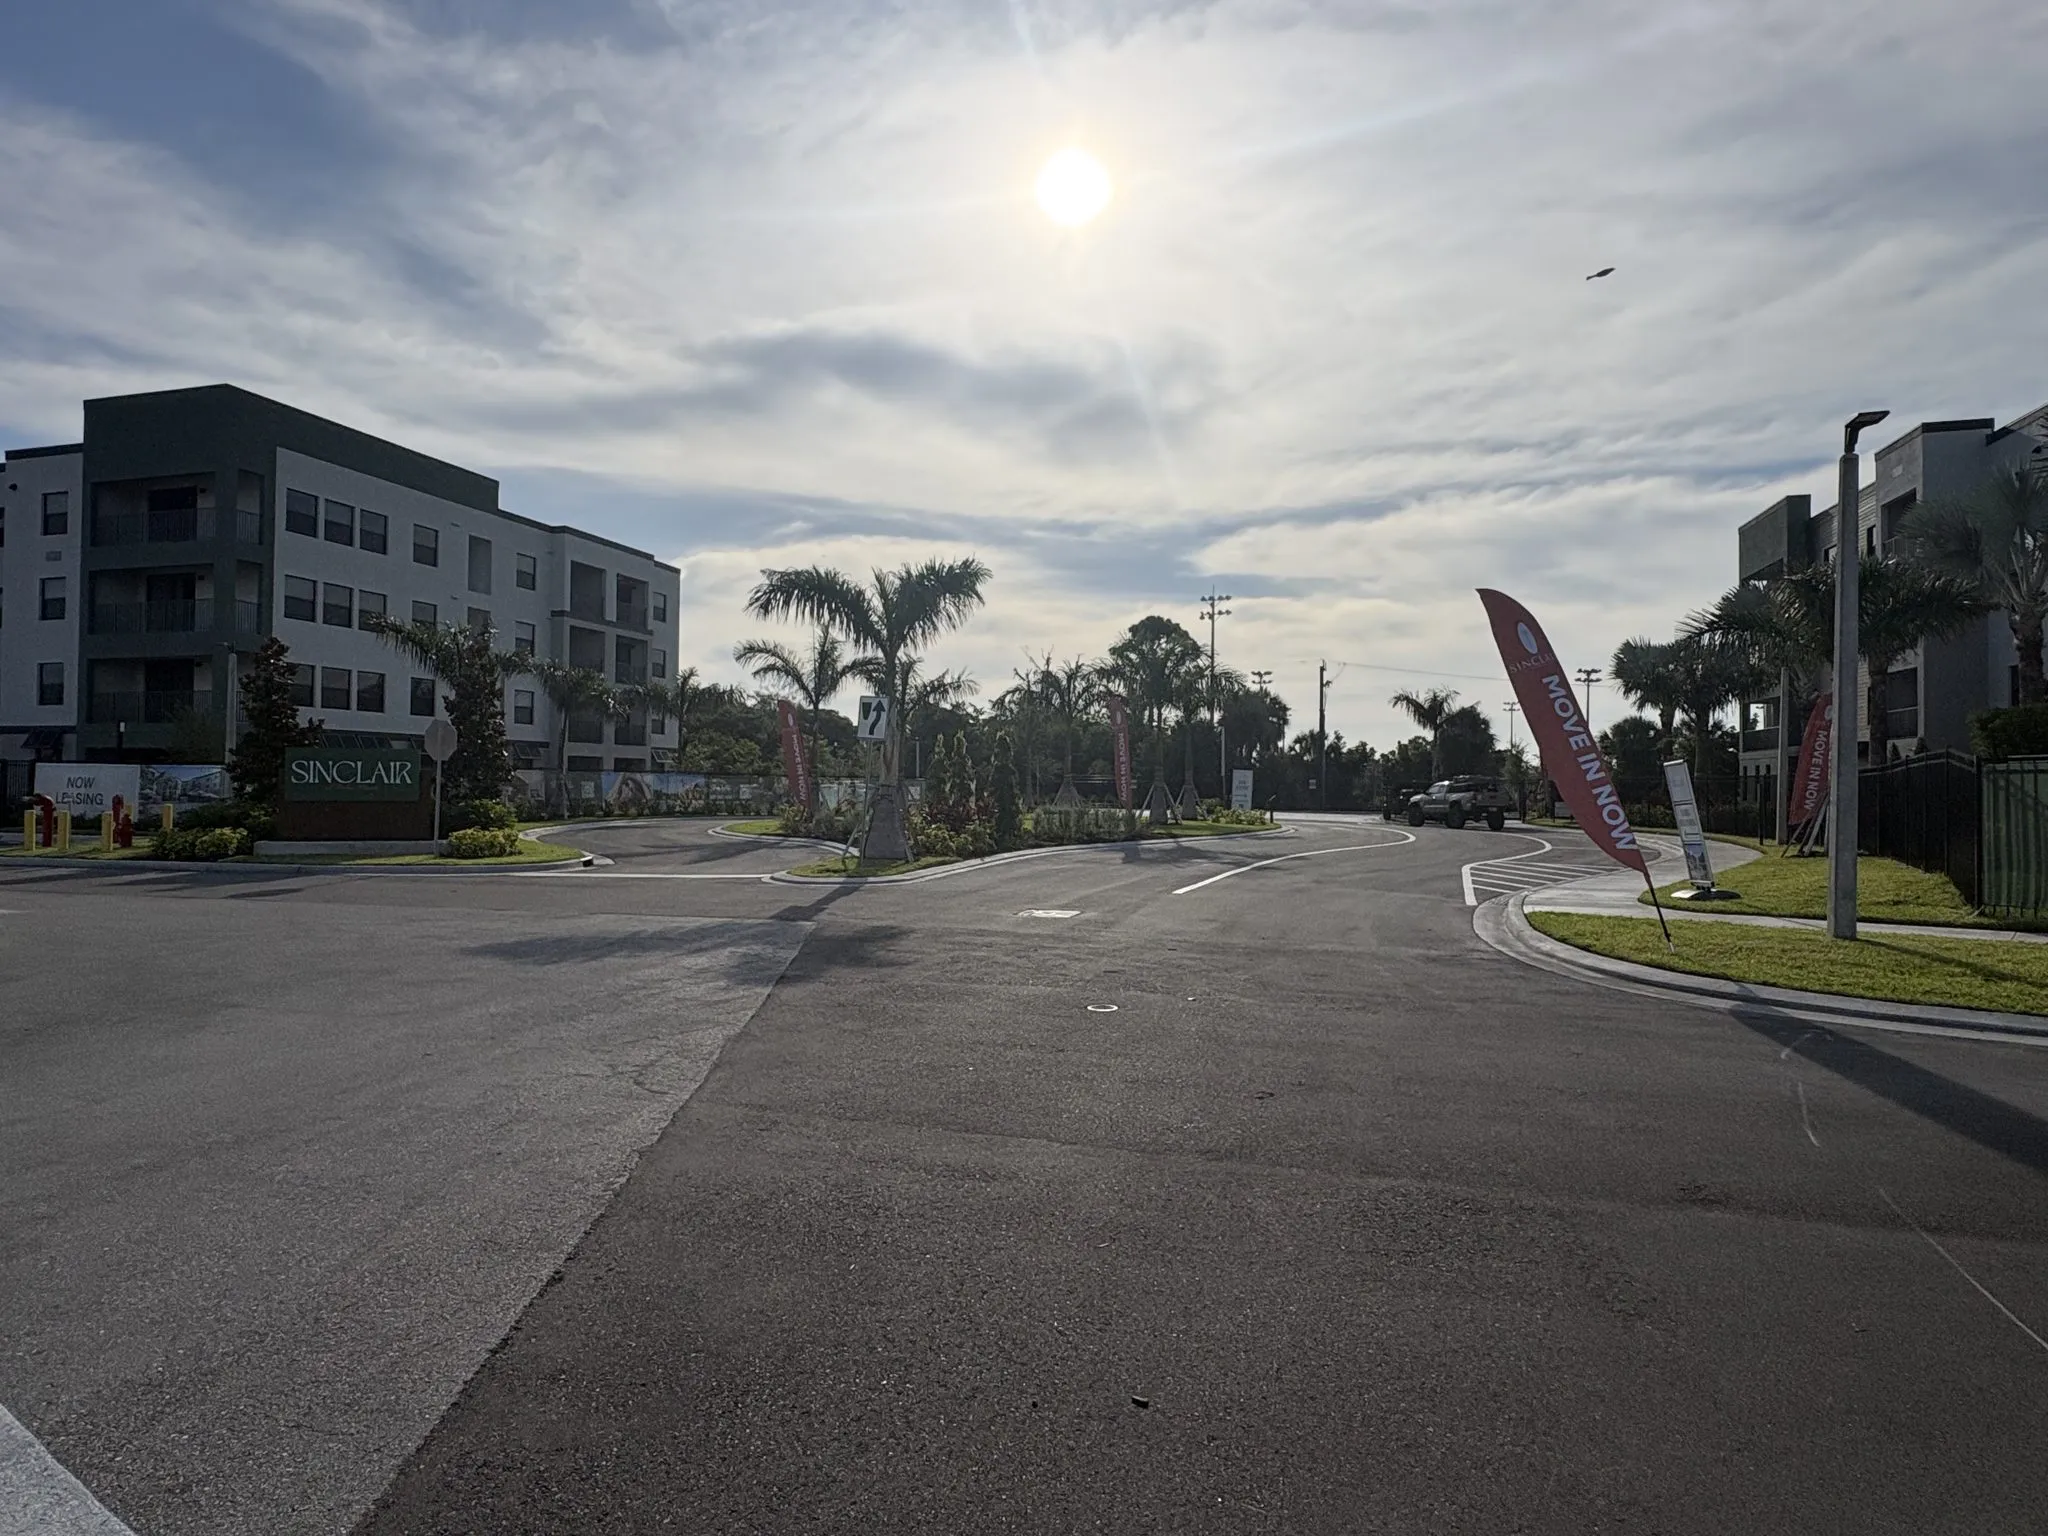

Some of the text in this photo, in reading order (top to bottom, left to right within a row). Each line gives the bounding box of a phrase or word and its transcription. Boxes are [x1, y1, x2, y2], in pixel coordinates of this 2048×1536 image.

[66, 776, 96, 789] NOW
[290, 760, 412, 784] SINCLAIR
[1542, 675, 1638, 849] MOVE IN NOW
[1804, 730, 1827, 810] MOVE IN NOW
